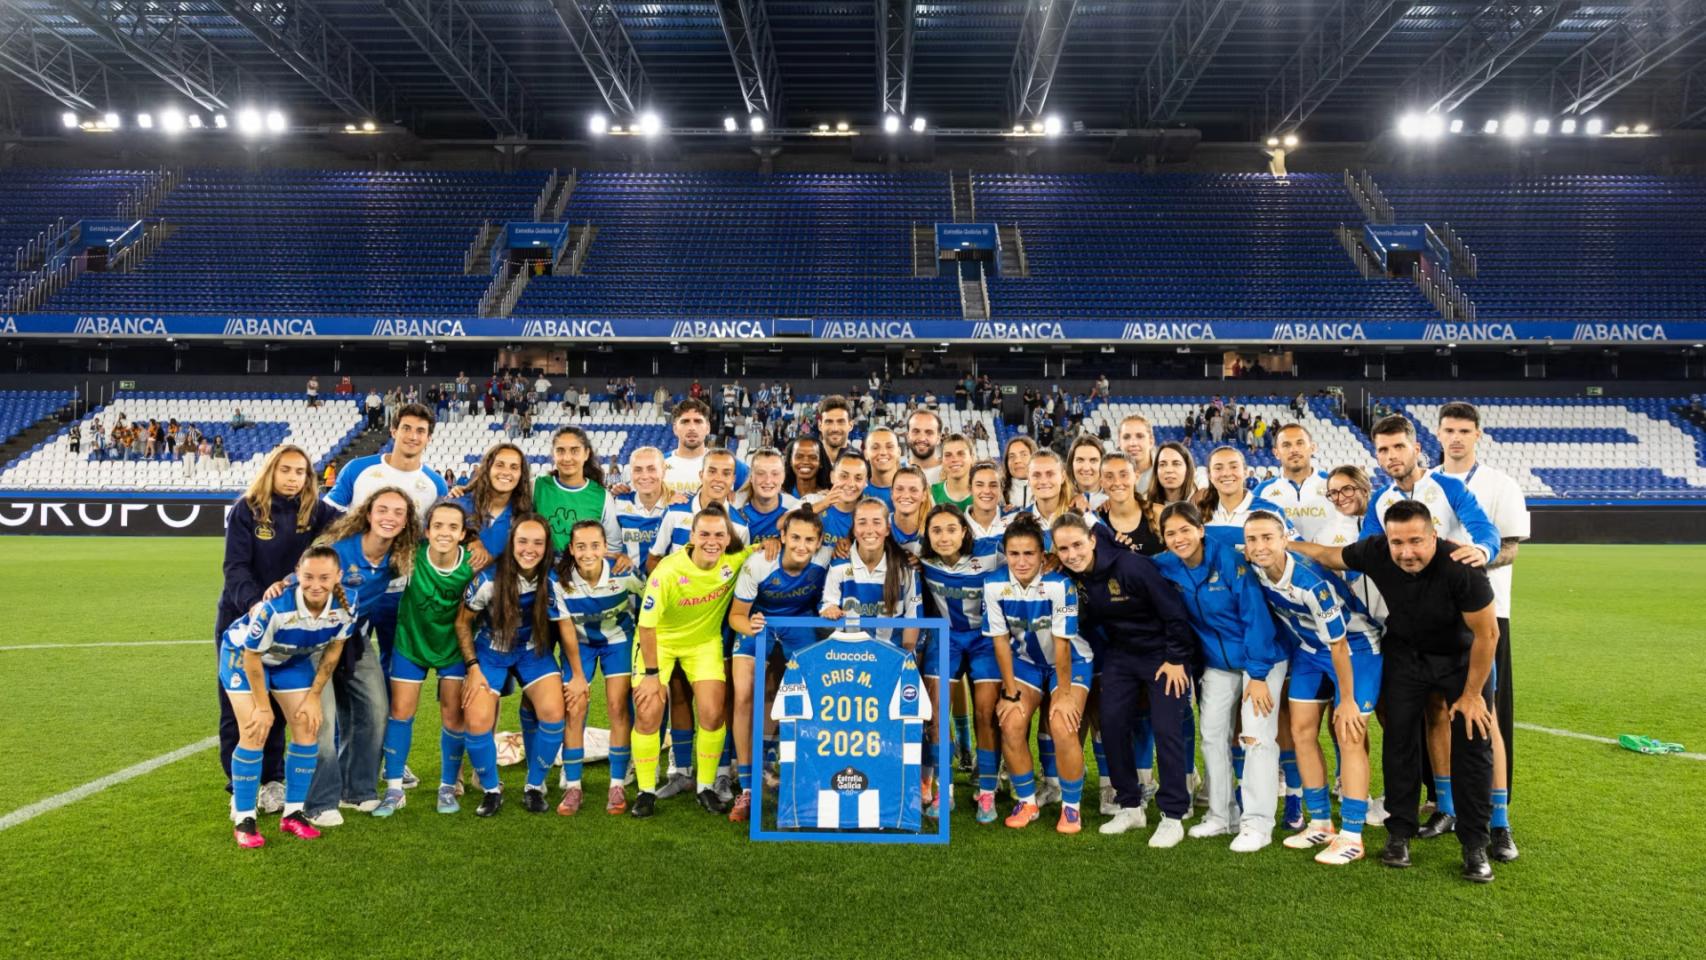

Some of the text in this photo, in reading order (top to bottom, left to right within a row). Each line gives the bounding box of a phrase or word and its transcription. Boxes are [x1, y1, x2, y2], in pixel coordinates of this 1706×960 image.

[1285, 506, 1328, 517] BANCA
[825, 649, 878, 662] duacode.
[822, 668, 873, 689] CRIS M.
[820, 696, 879, 722] 2016
[817, 730, 881, 757] 2026
